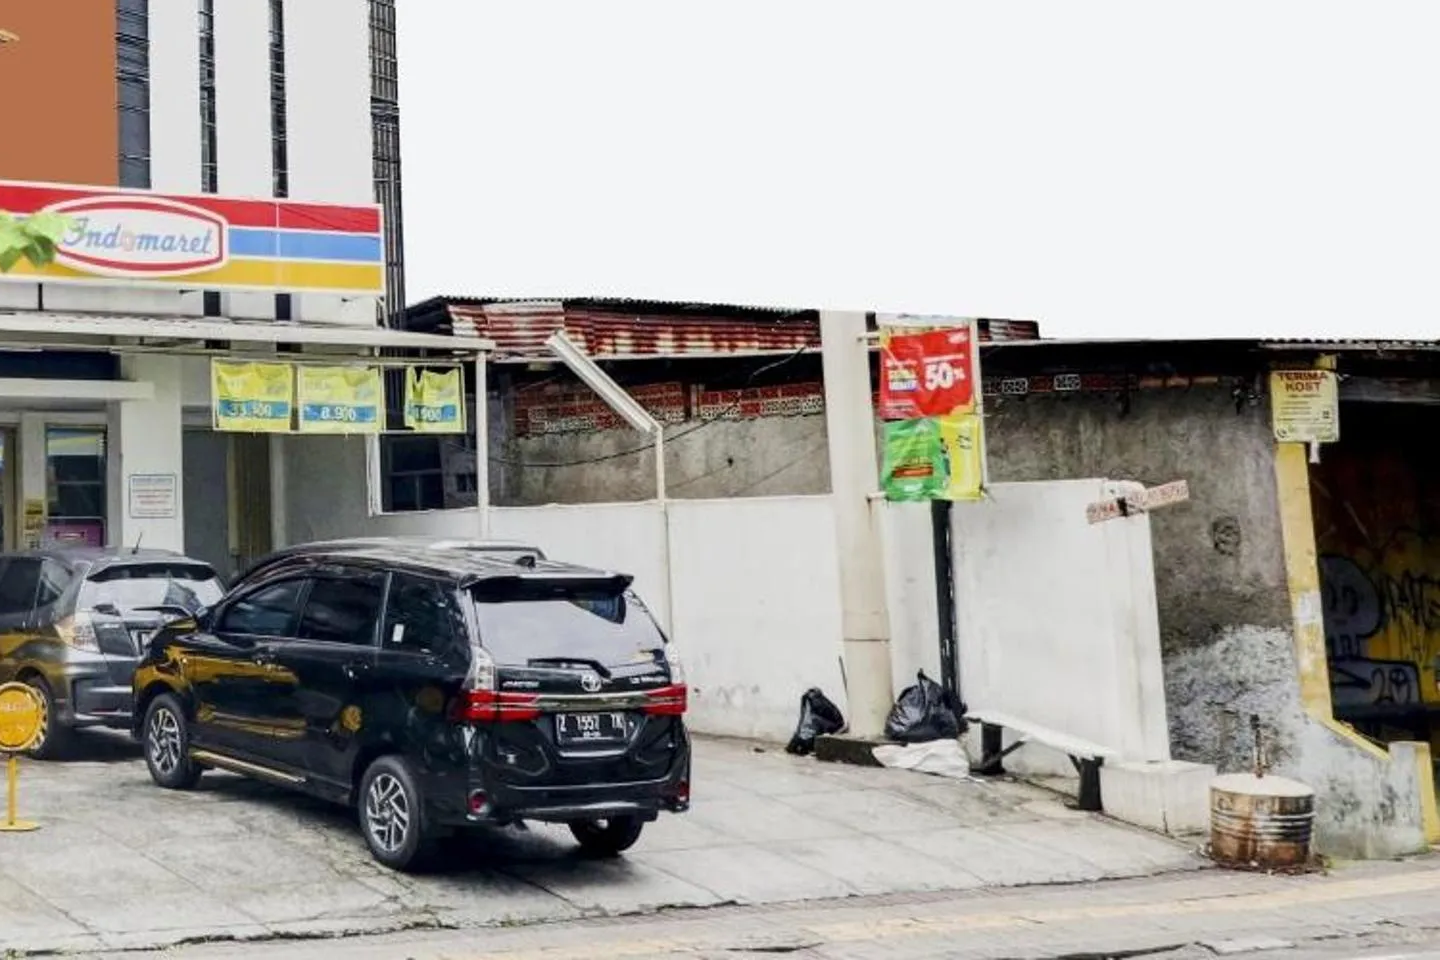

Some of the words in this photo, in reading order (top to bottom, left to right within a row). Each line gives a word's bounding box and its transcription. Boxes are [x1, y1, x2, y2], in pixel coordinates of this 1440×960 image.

[61, 216, 213, 254] Indomaret
[1276, 371, 1329, 382] TERIMA
[1285, 381, 1320, 392] KOST
